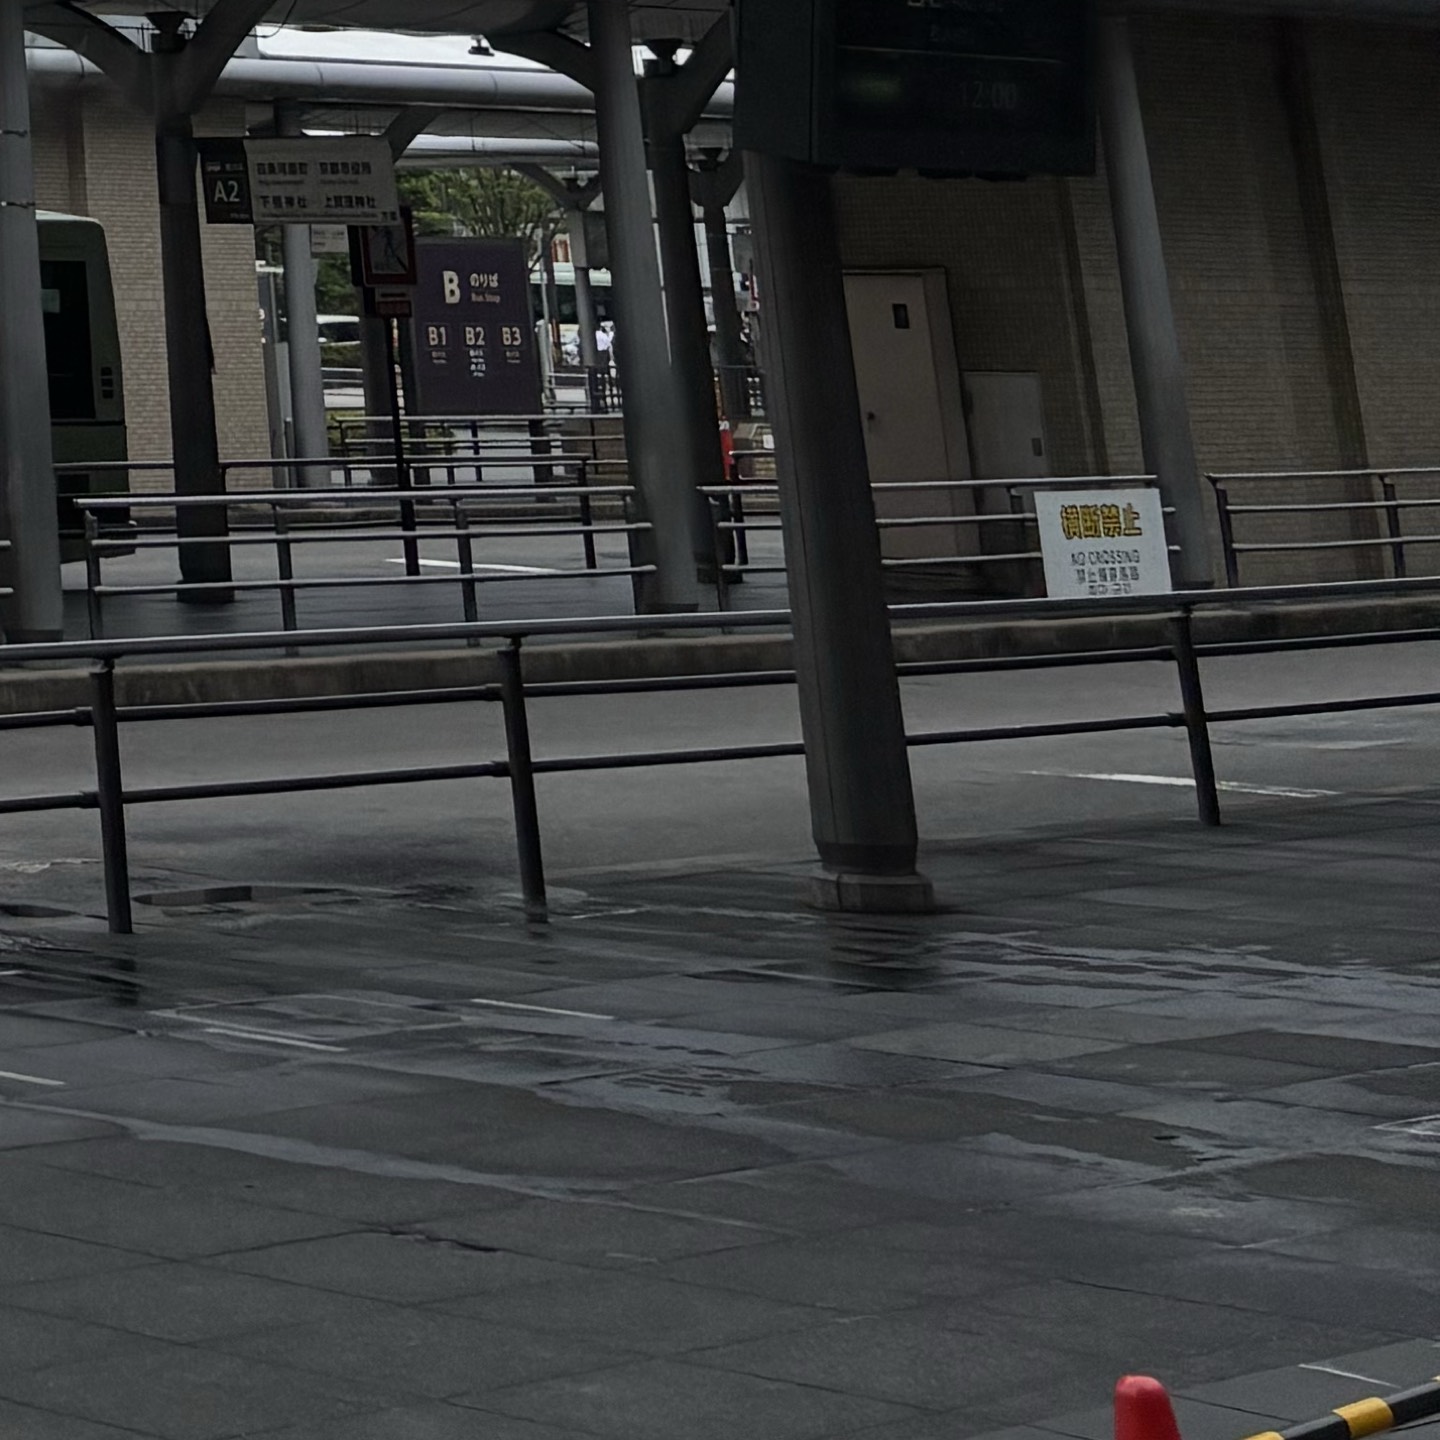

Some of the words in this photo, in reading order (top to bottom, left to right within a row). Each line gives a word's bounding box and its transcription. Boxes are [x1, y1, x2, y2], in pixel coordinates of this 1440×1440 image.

[214, 180, 241, 203] A2
[442, 270, 461, 305] B
[428, 326, 447, 346] B1
[465, 326, 485, 346] B2
[501, 326, 522, 346] B3
[1060, 503, 1143, 540] 横断禁止
[1088, 549, 1141, 565] CROSSING
